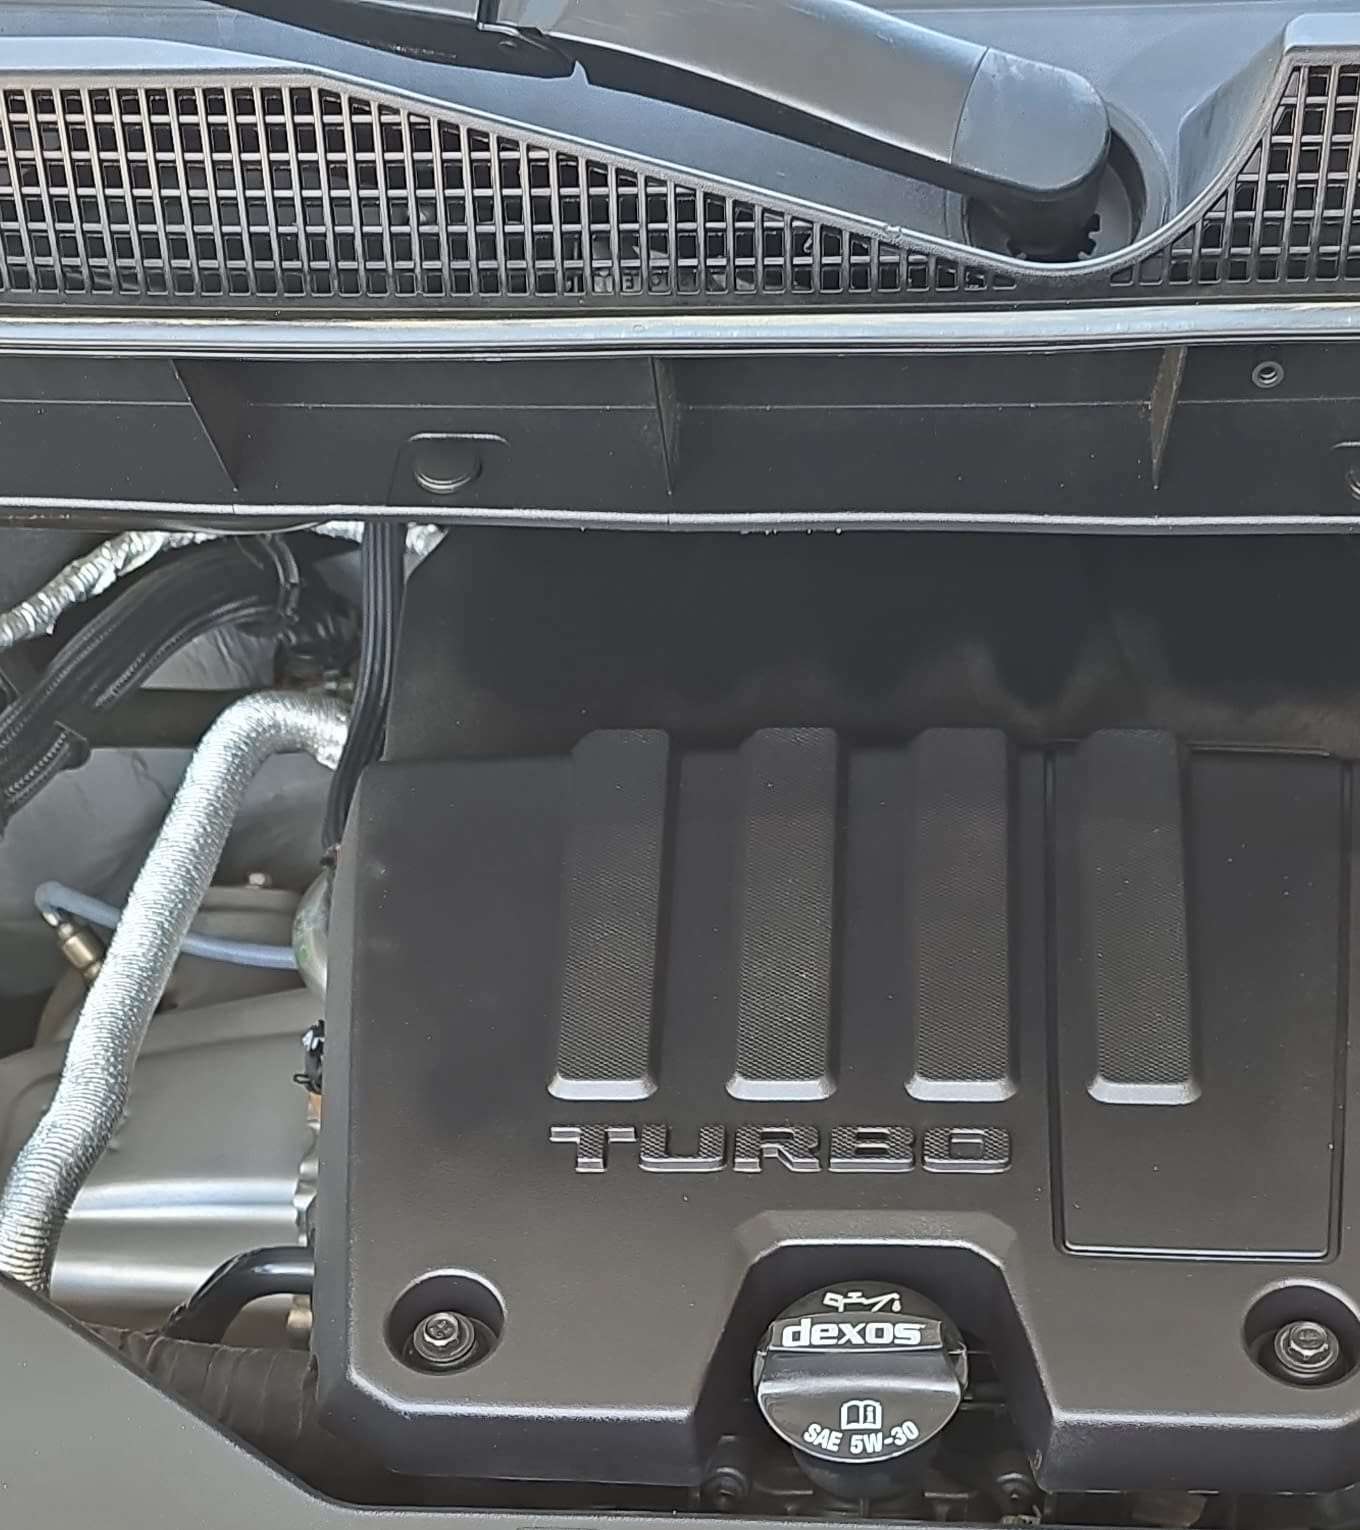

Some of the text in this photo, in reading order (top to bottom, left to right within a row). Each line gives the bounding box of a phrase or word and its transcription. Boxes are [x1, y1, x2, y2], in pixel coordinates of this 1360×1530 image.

[549, 1124, 1011, 1173] TURBO
[782, 1318, 924, 1347] dexos
[803, 1420, 920, 1455] SAE 5W-30
